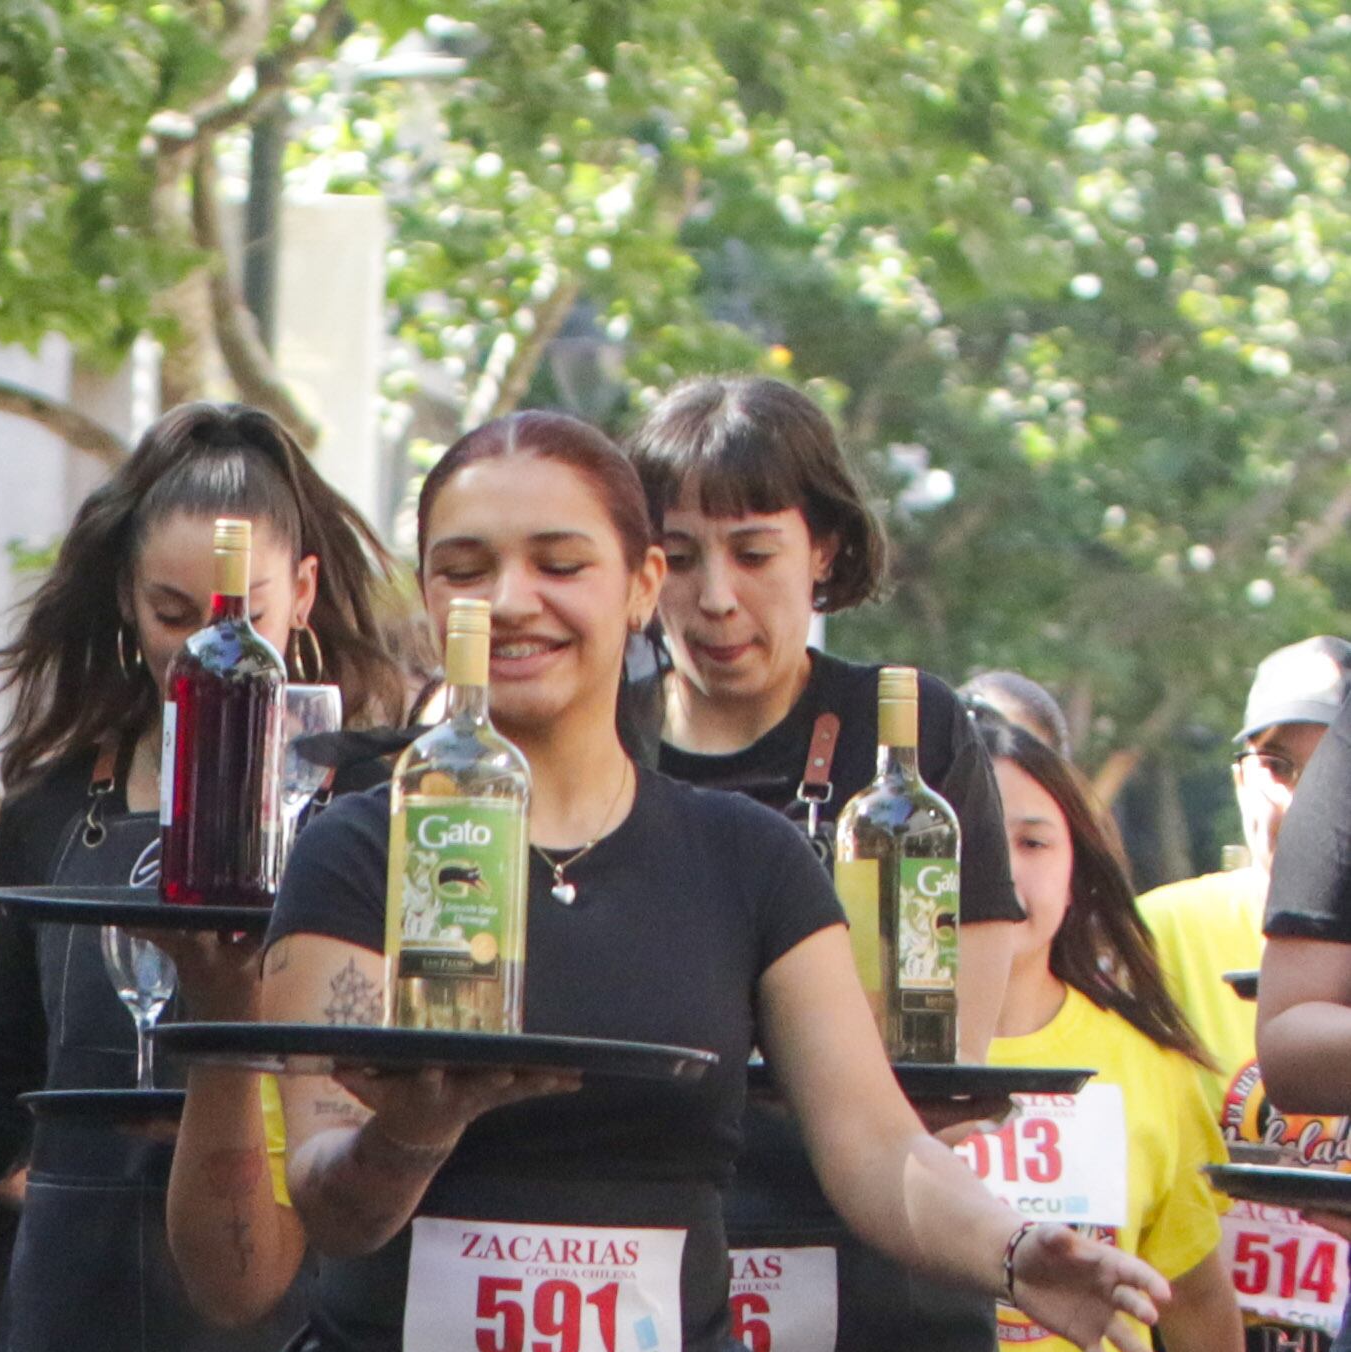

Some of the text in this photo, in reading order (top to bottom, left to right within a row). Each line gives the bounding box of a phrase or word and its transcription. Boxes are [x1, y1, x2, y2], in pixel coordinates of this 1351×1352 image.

[418, 815, 492, 849] Gato
[1017, 1196, 1062, 1213] CCU
[460, 1232, 640, 1266] ZACARIAS
[525, 1265, 638, 1281] COCINA CHILENA
[1232, 1231, 1337, 1304] 514
[731, 1281, 781, 1292] HILENA
